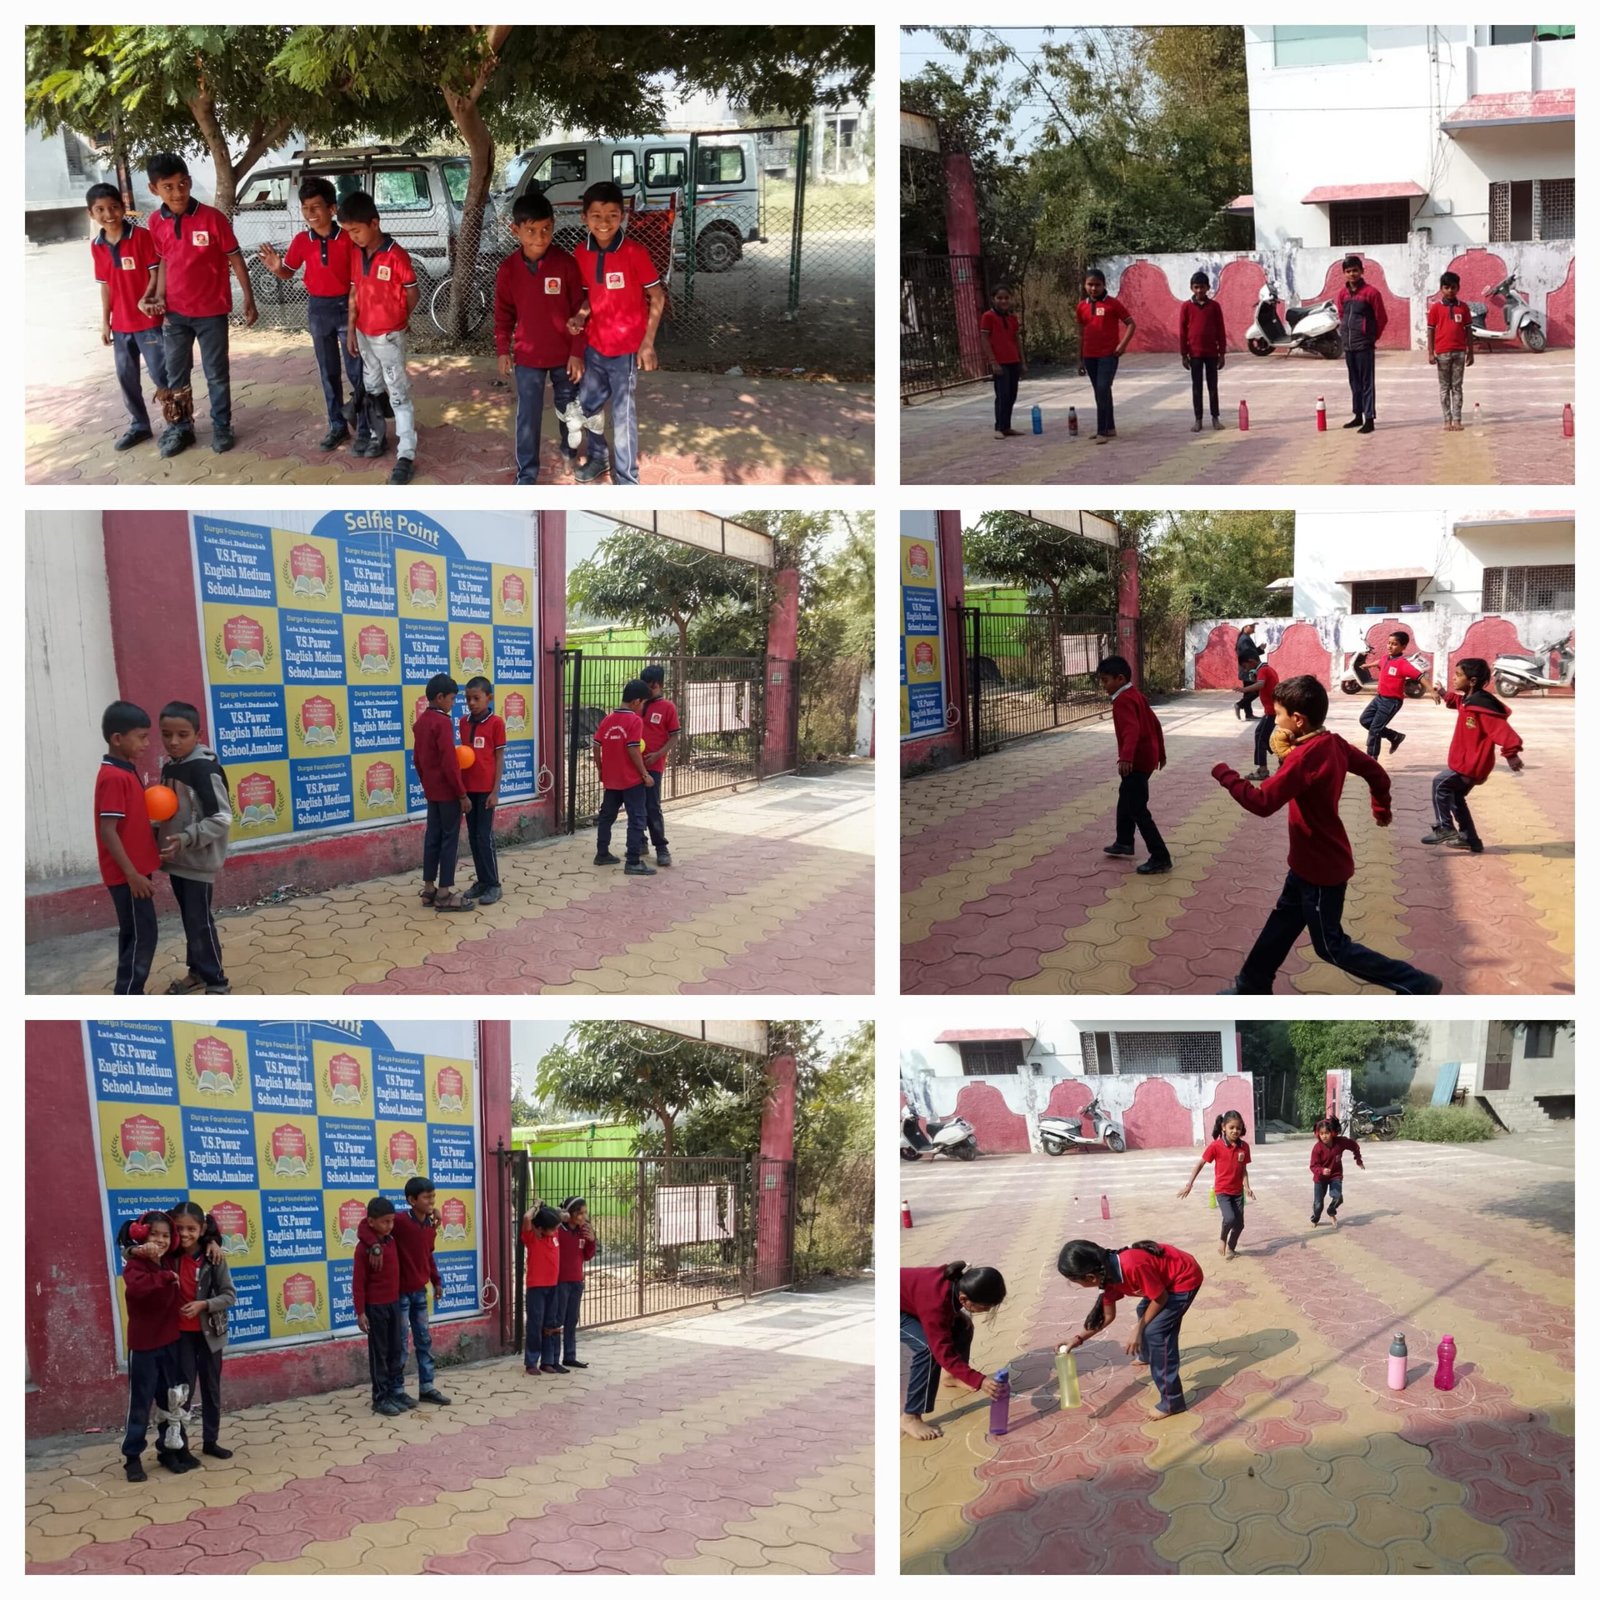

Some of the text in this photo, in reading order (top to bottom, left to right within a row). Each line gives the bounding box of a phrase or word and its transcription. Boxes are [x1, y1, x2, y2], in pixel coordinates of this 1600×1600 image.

[344, 510, 440, 545] Selfie Point
[216, 548, 257, 565] V.S.Pawar
[204, 562, 271, 581] English Medium
[354, 567, 385, 581] V.S.Pawar
[207, 582, 271, 599] School,Amalner
[344, 580, 395, 596] English Medium
[458, 580, 482, 592] V.S.Pawar
[346, 596, 394, 611] School,Amalner
[451, 592, 490, 605] English Medium
[296, 636, 330, 648] V.S.Pawar
[412, 642, 439, 652] V.S.Pawar
[286, 650, 342, 664] English Medium
[404, 654, 448, 666] English Medium
[288, 667, 342, 679] School,Amalner
[231, 712, 270, 723] V.S.Pawar
[362, 708, 392, 718] V.S.Pawar
[220, 726, 283, 741] English Medium
[353, 721, 402, 734] English Medium
[355, 735, 401, 747] School,Amalner
[223, 742, 283, 756] School,Amalner
[306, 783, 339, 794] V.S.Pawar
[296, 794, 350, 811] English Medium
[299, 809, 350, 824] School,Amalner
[112, 1043, 157, 1060] V.S.Pawar
[98, 1058, 173, 1078] English Medium
[266, 1061, 301, 1076] V.S.Pawar
[102, 1079, 173, 1097] School,Amalner
[255, 1075, 313, 1091] English Medium
[386, 1075, 414, 1087] V.S.Pawar
[258, 1093, 312, 1108] School,Amalner
[377, 1087, 423, 1101] English Medium
[202, 1137, 240, 1150] V.S.Pawar
[334, 1142, 365, 1154] V.S.Pawar
[190, 1152, 254, 1167] English Medium
[325, 1156, 376, 1169] English Medium
[193, 1170, 253, 1182] School,Amalner
[327, 1172, 375, 1183] School,Amalner
[278, 1215, 311, 1226] V.S.Pawar
[268, 1229, 323, 1243] English Medium
[270, 1245, 322, 1257] School,Amalner
[236, 1308, 266, 1320] Medium
